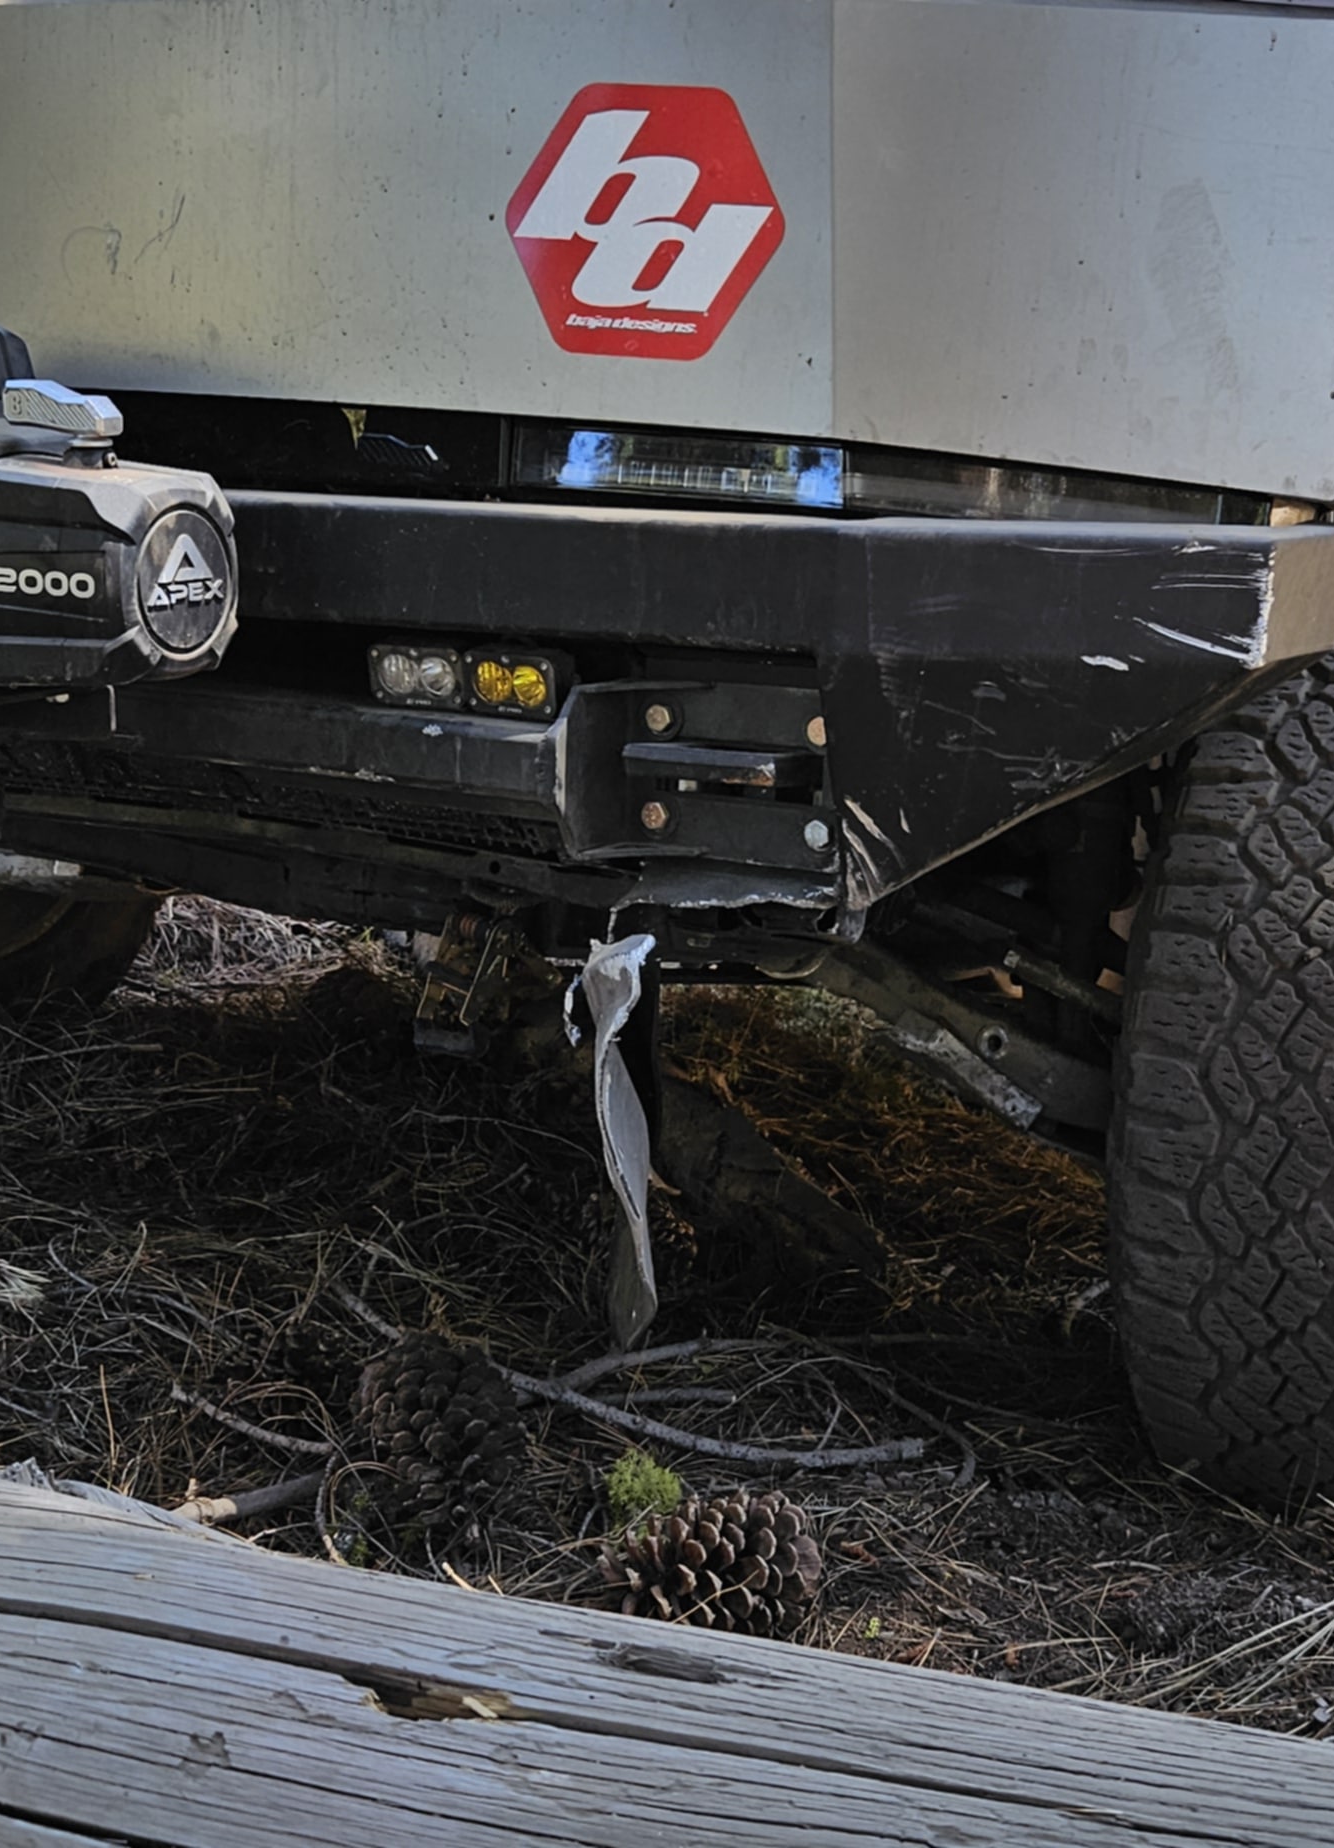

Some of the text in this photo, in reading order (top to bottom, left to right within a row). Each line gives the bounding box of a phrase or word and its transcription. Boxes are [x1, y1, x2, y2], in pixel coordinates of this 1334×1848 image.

[566, 312, 697, 334] baja designs
[147, 579, 225, 607] APEX
